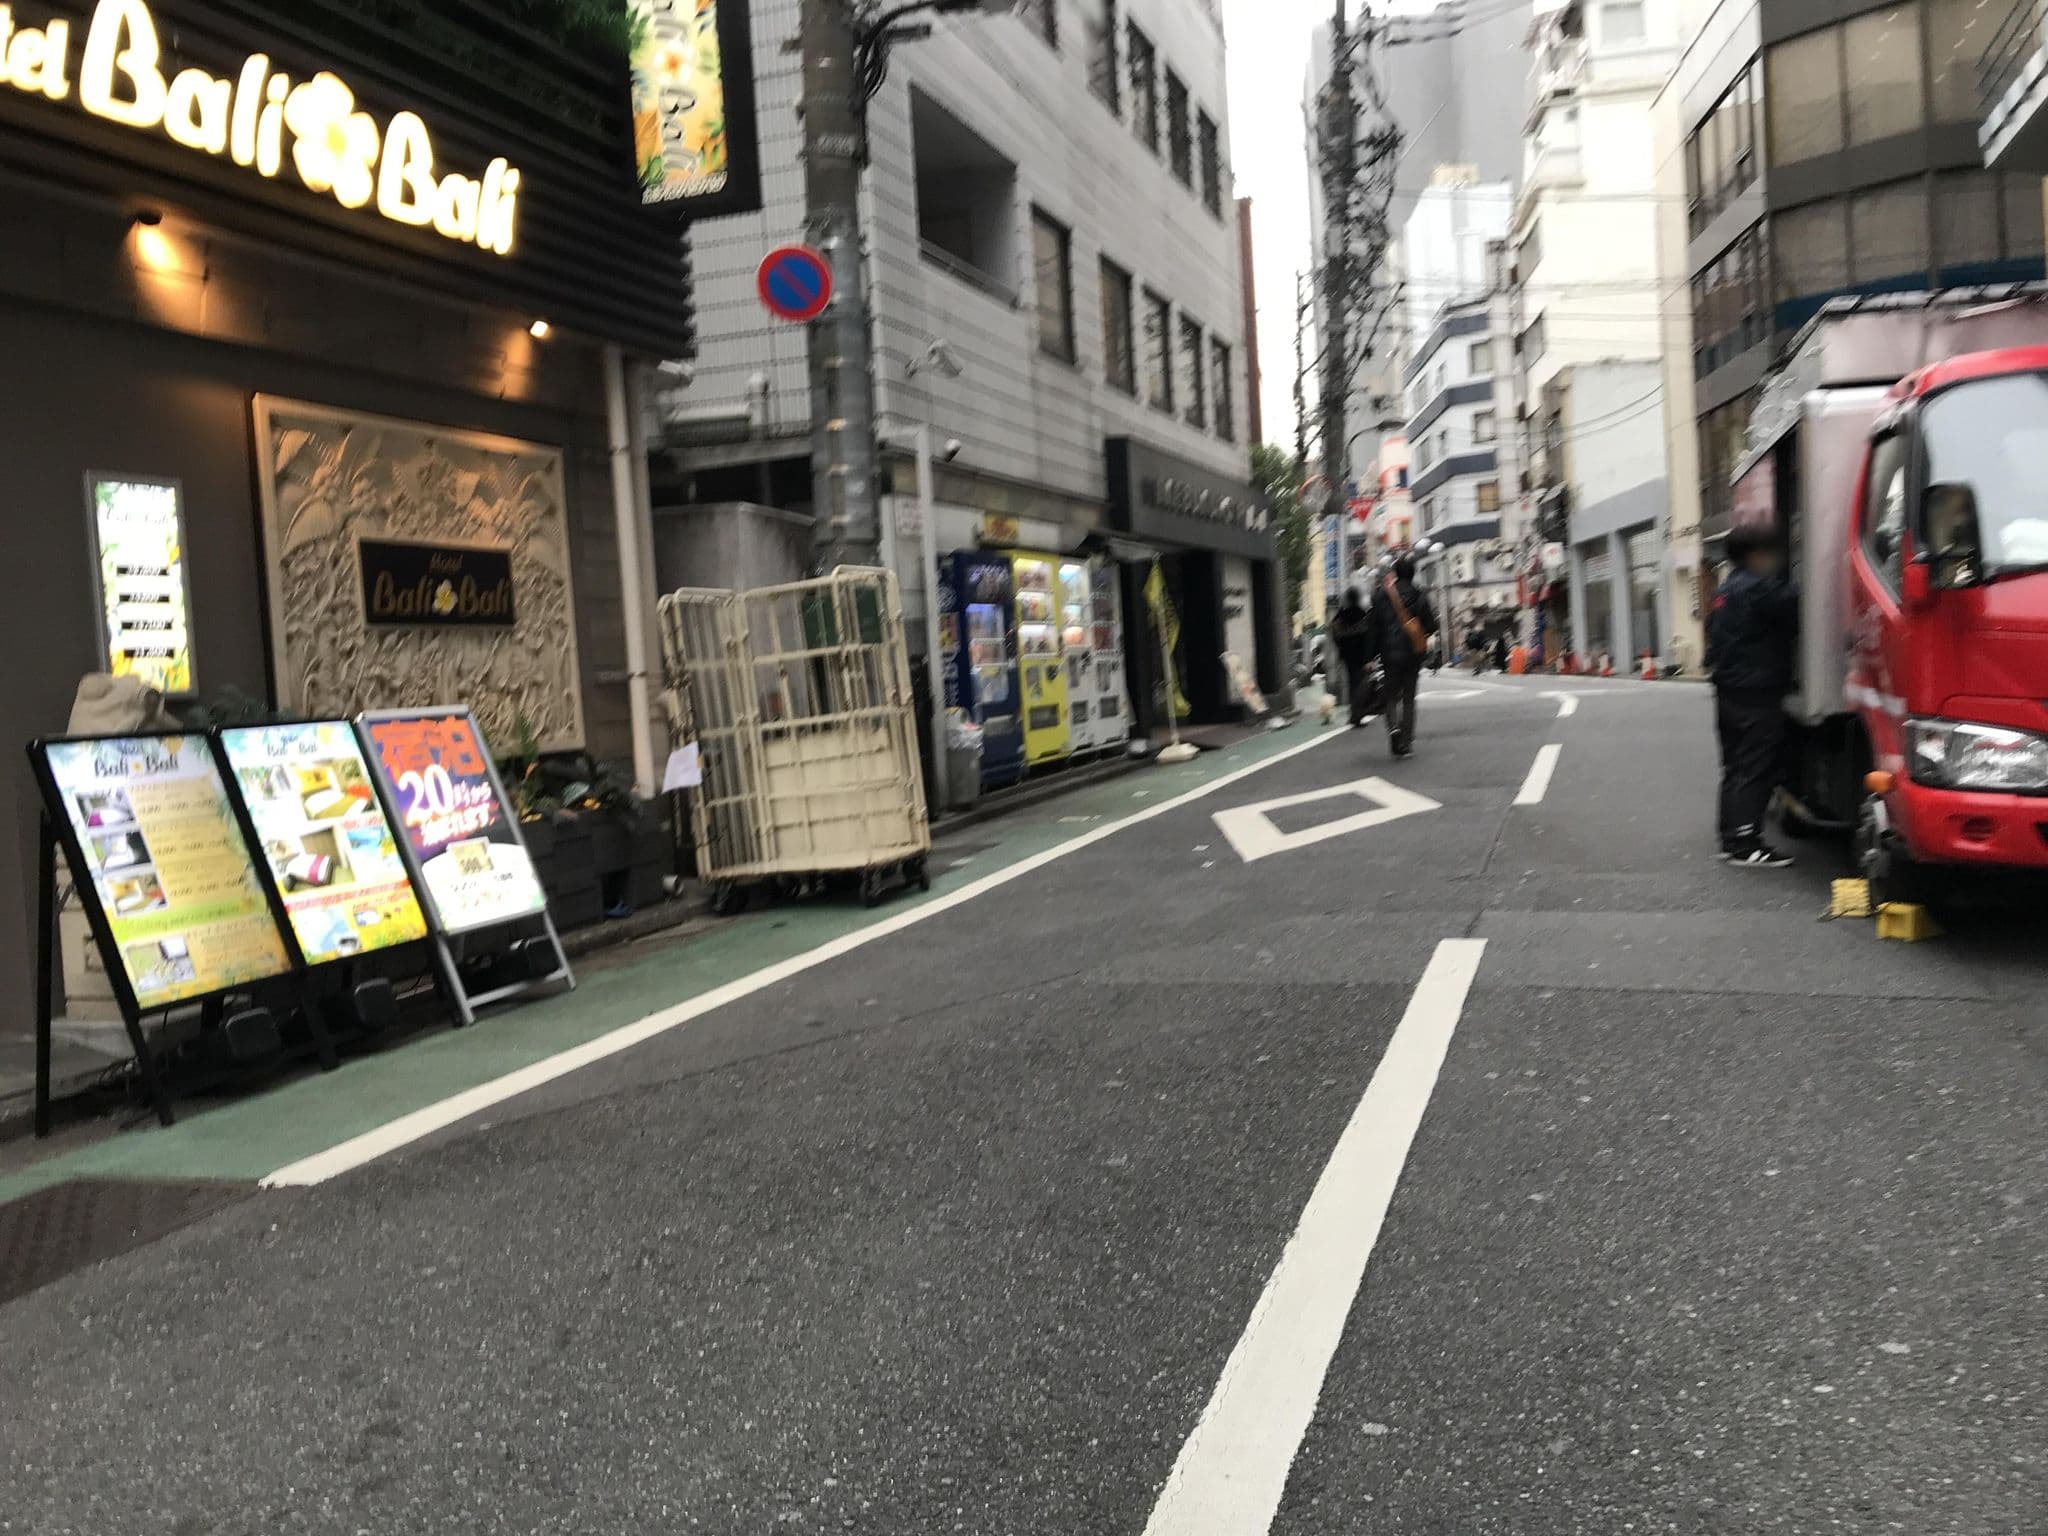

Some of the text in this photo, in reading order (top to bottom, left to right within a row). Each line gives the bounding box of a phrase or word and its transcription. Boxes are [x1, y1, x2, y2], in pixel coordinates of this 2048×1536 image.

[80, 0, 288, 177] Bali
[377, 111, 519, 254] Bali
[373, 570, 512, 615] Bali Bali
